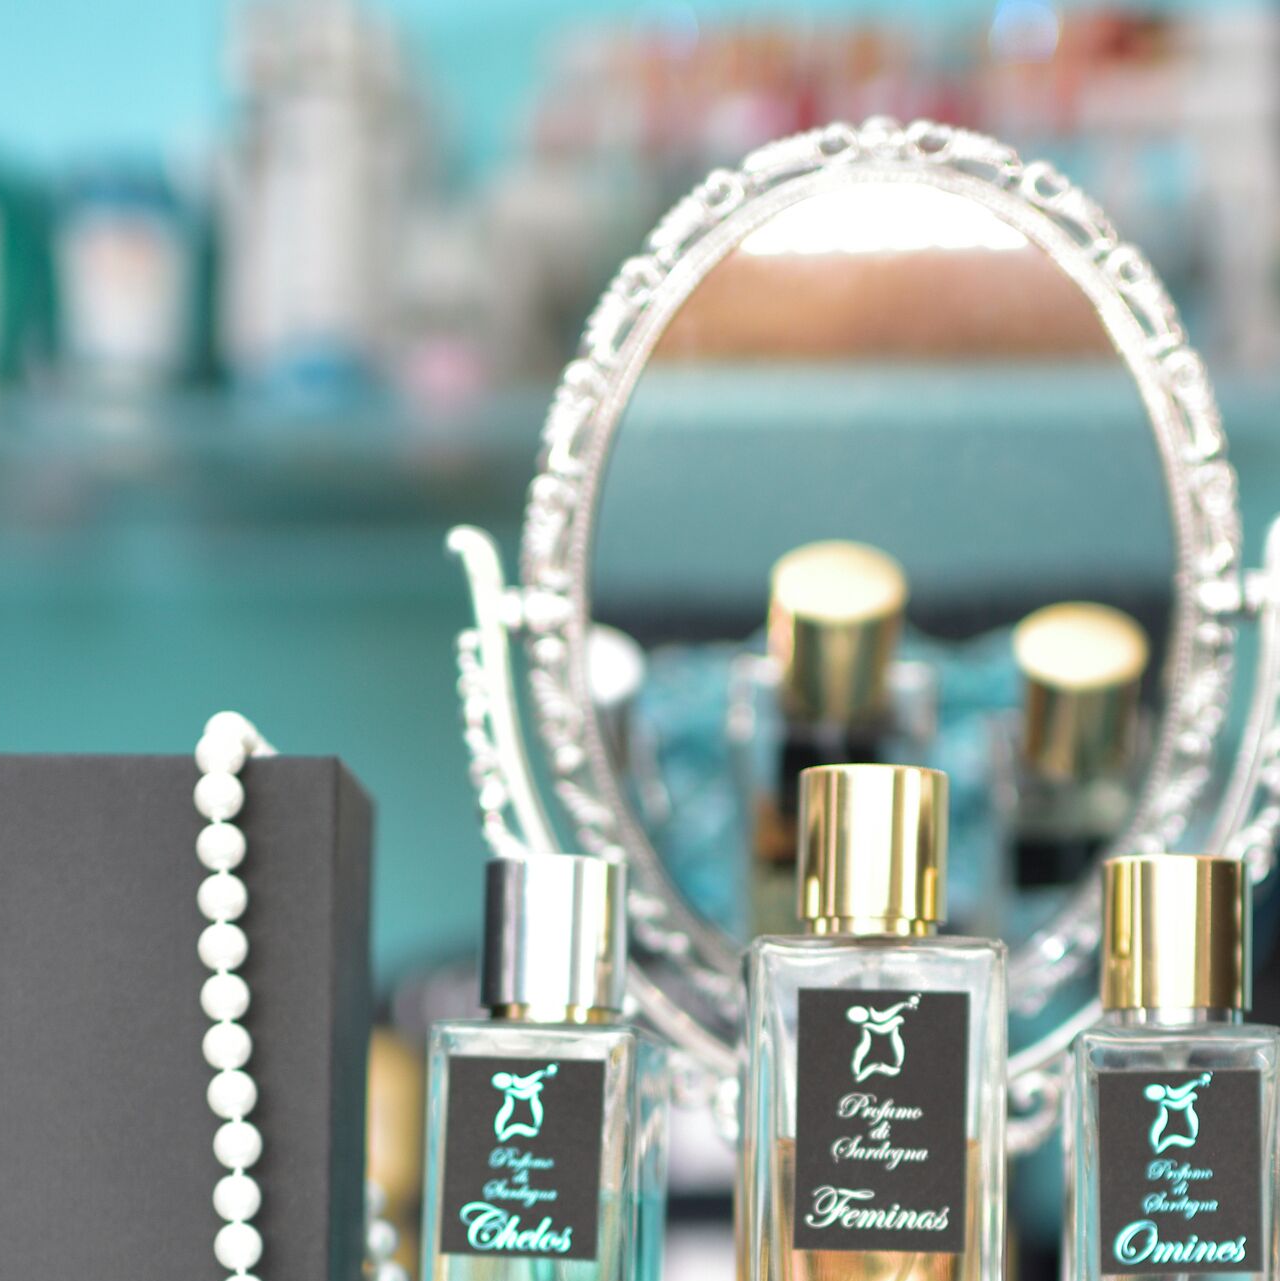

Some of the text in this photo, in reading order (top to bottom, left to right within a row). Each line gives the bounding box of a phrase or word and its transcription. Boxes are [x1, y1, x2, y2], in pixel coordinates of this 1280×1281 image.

[837, 1092, 924, 1126] Profumo
[869, 1120, 892, 1140] di
[831, 1135, 929, 1170] Sardegna
[1146, 1159, 1214, 1184] Profumo
[805, 1185, 950, 1231] Feminas
[1142, 1191, 1219, 1220] Sardegna
[459, 1201, 573, 1253] Chelos
[1113, 1219, 1247, 1265] Omines
